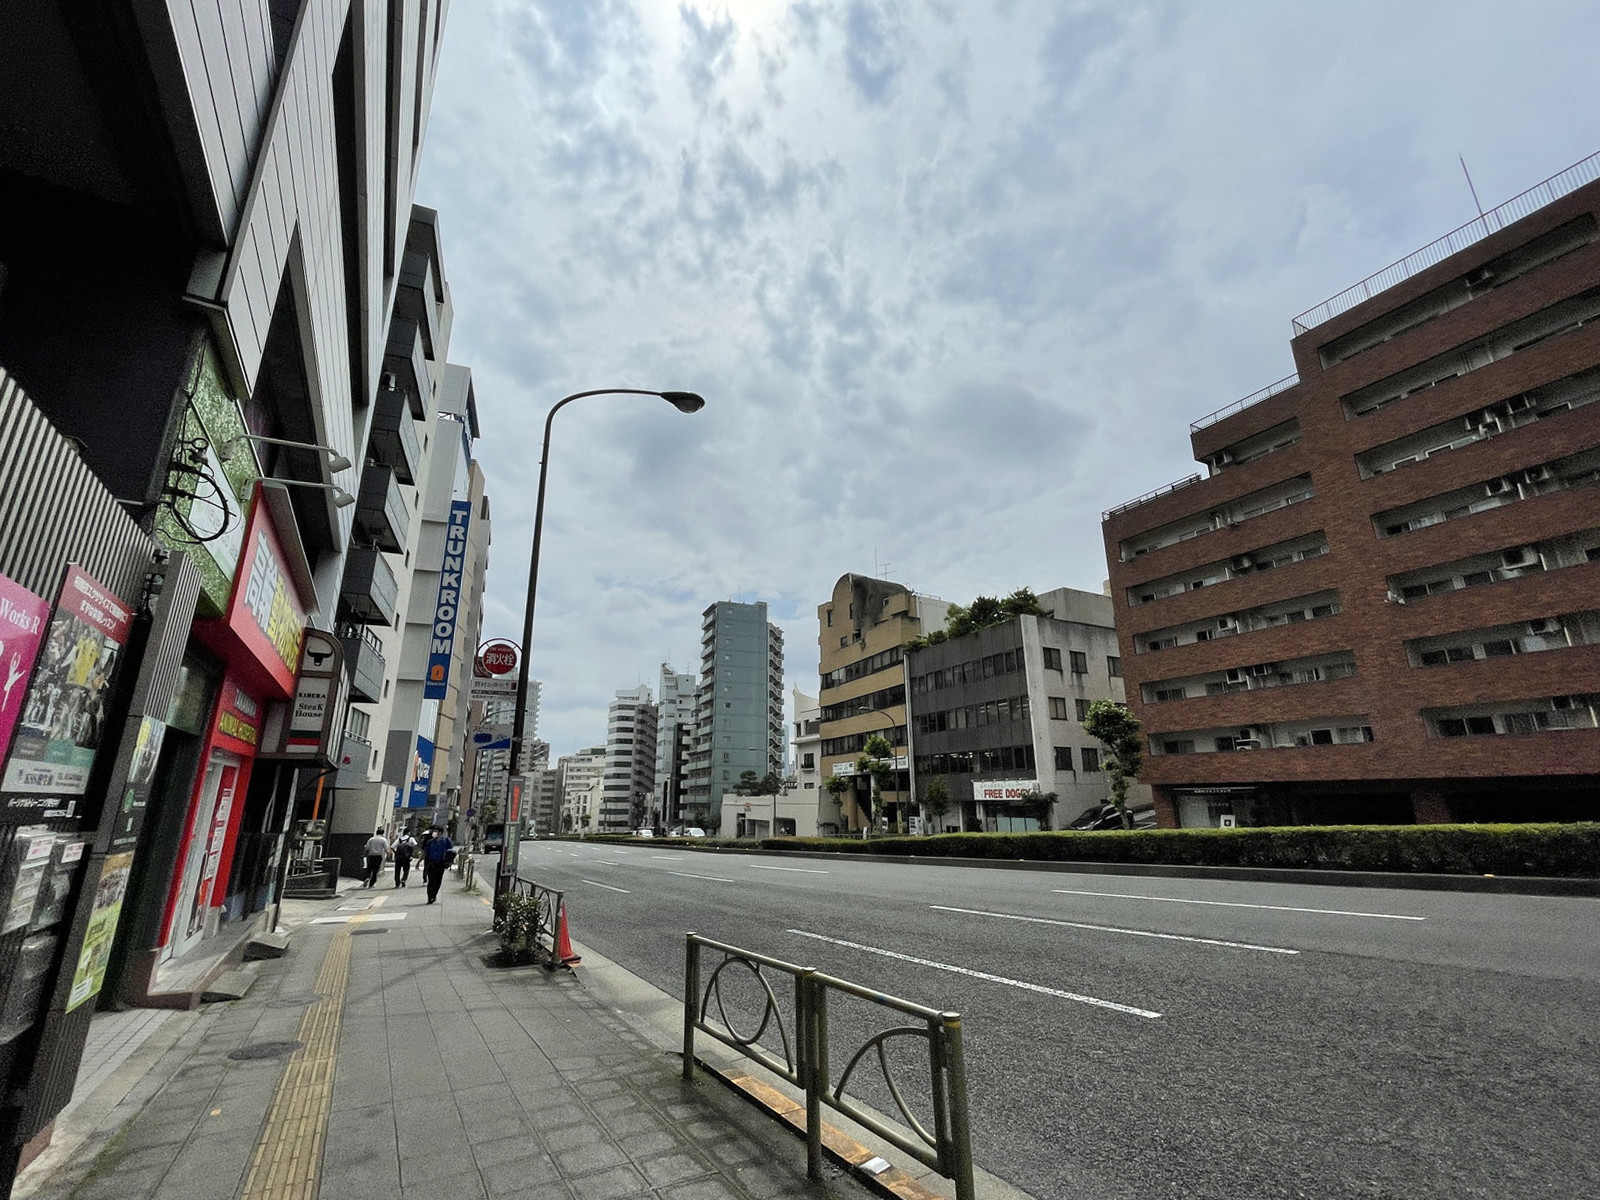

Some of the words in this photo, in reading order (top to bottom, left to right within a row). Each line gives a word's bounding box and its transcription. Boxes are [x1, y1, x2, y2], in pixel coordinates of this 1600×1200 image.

[431, 510, 468, 655] TRUNKROOM
[0, 597, 31, 631] Works
[31, 616, 41, 635] R
[485, 652, 514, 667] 消火栓
[295, 710, 323, 718] House
[984, 788, 1004, 799] FREE
